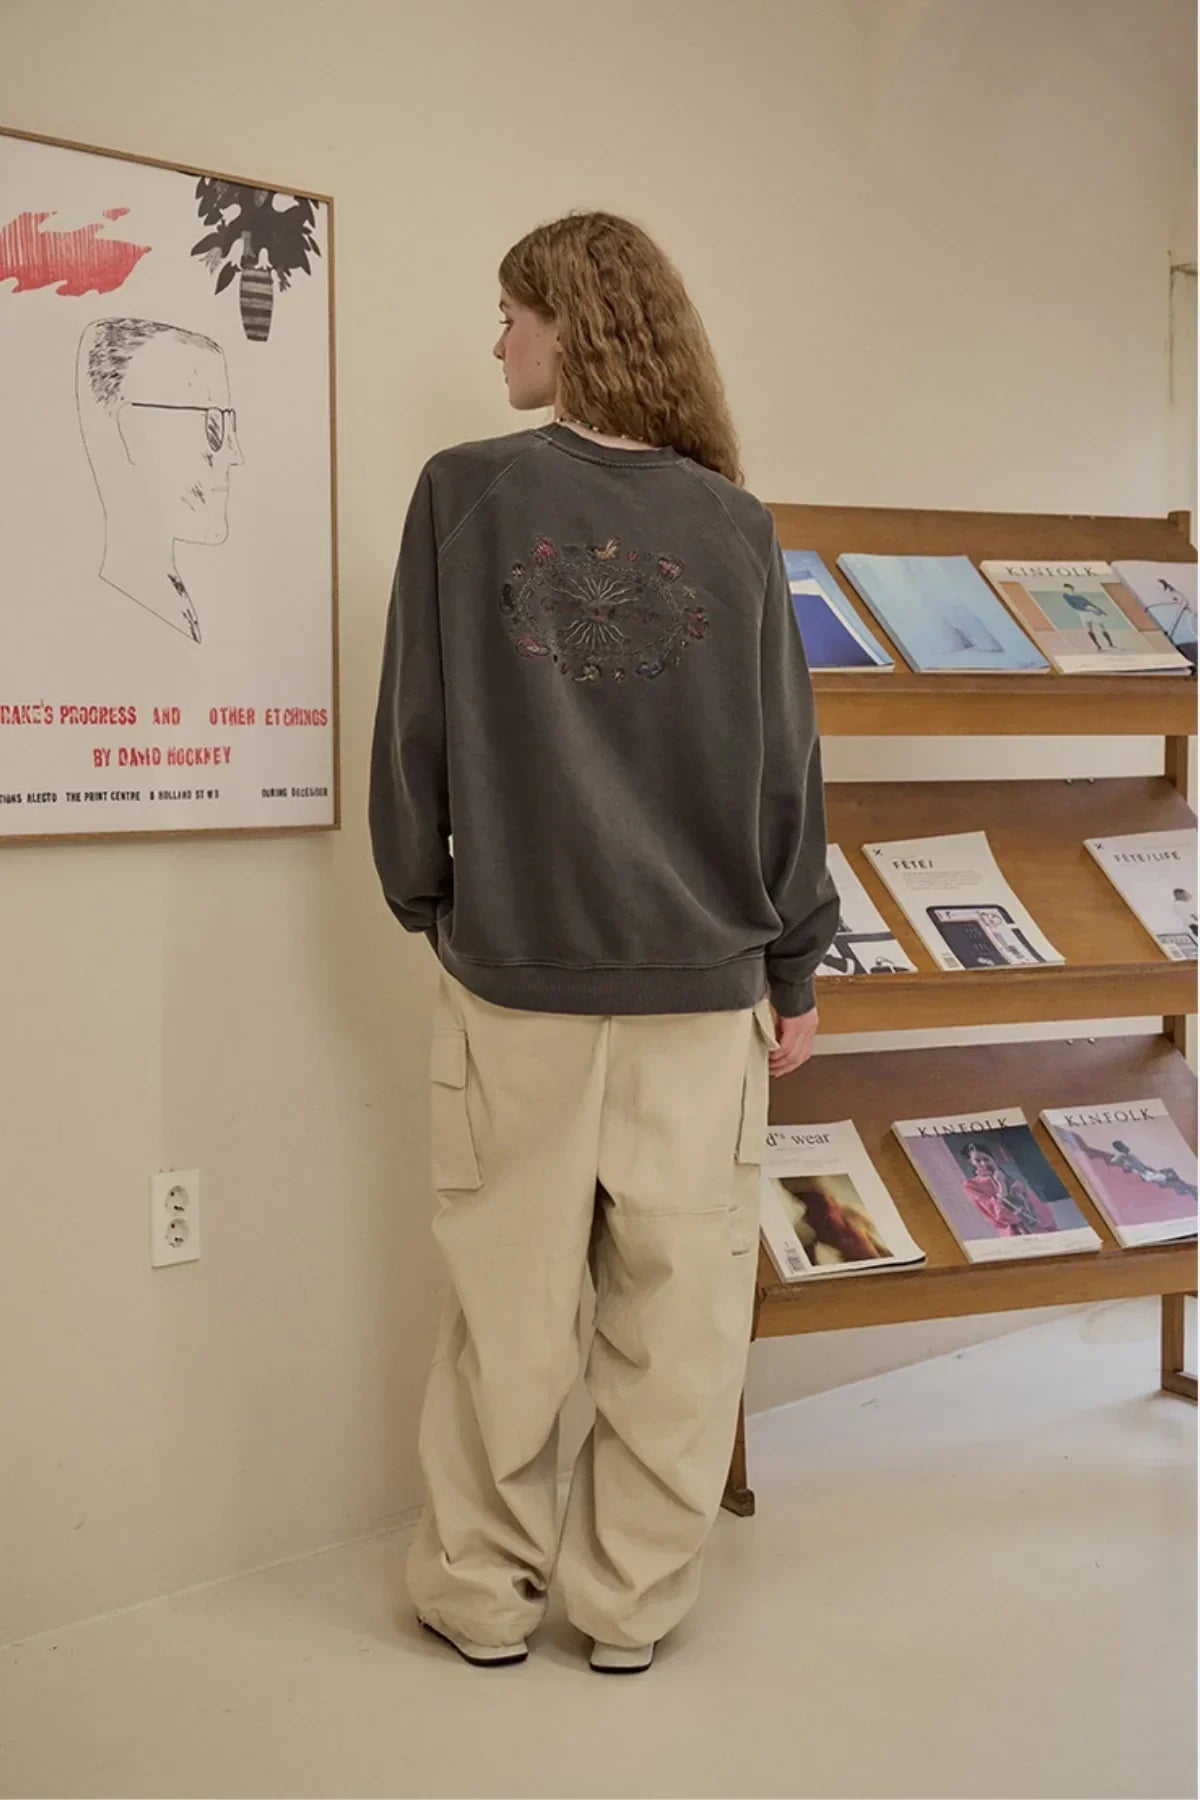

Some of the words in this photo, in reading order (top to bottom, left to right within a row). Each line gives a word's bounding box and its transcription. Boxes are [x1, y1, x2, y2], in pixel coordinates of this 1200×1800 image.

[1004, 565, 1099, 577] KINFOLK
[59, 705, 137, 725] PROGRESS
[152, 706, 181, 726] AND
[208, 707, 256, 726] OTHER
[265, 707, 328, 727] ETCHINGS
[92, 748, 111, 768] BY
[118, 747, 162, 768] DAVID
[167, 746, 231, 766] HOCKNEY
[65, 791, 81, 802] THE
[84, 791, 108, 802] PRINT
[110, 790, 140, 802] CENTRE
[158, 789, 192, 800] HOLLAND
[195, 789, 204, 800] ST
[1063, 1107, 1155, 1127] KINFOLK
[917, 1117, 1010, 1138] KINFOLK
[791, 1133, 830, 1145] wear
